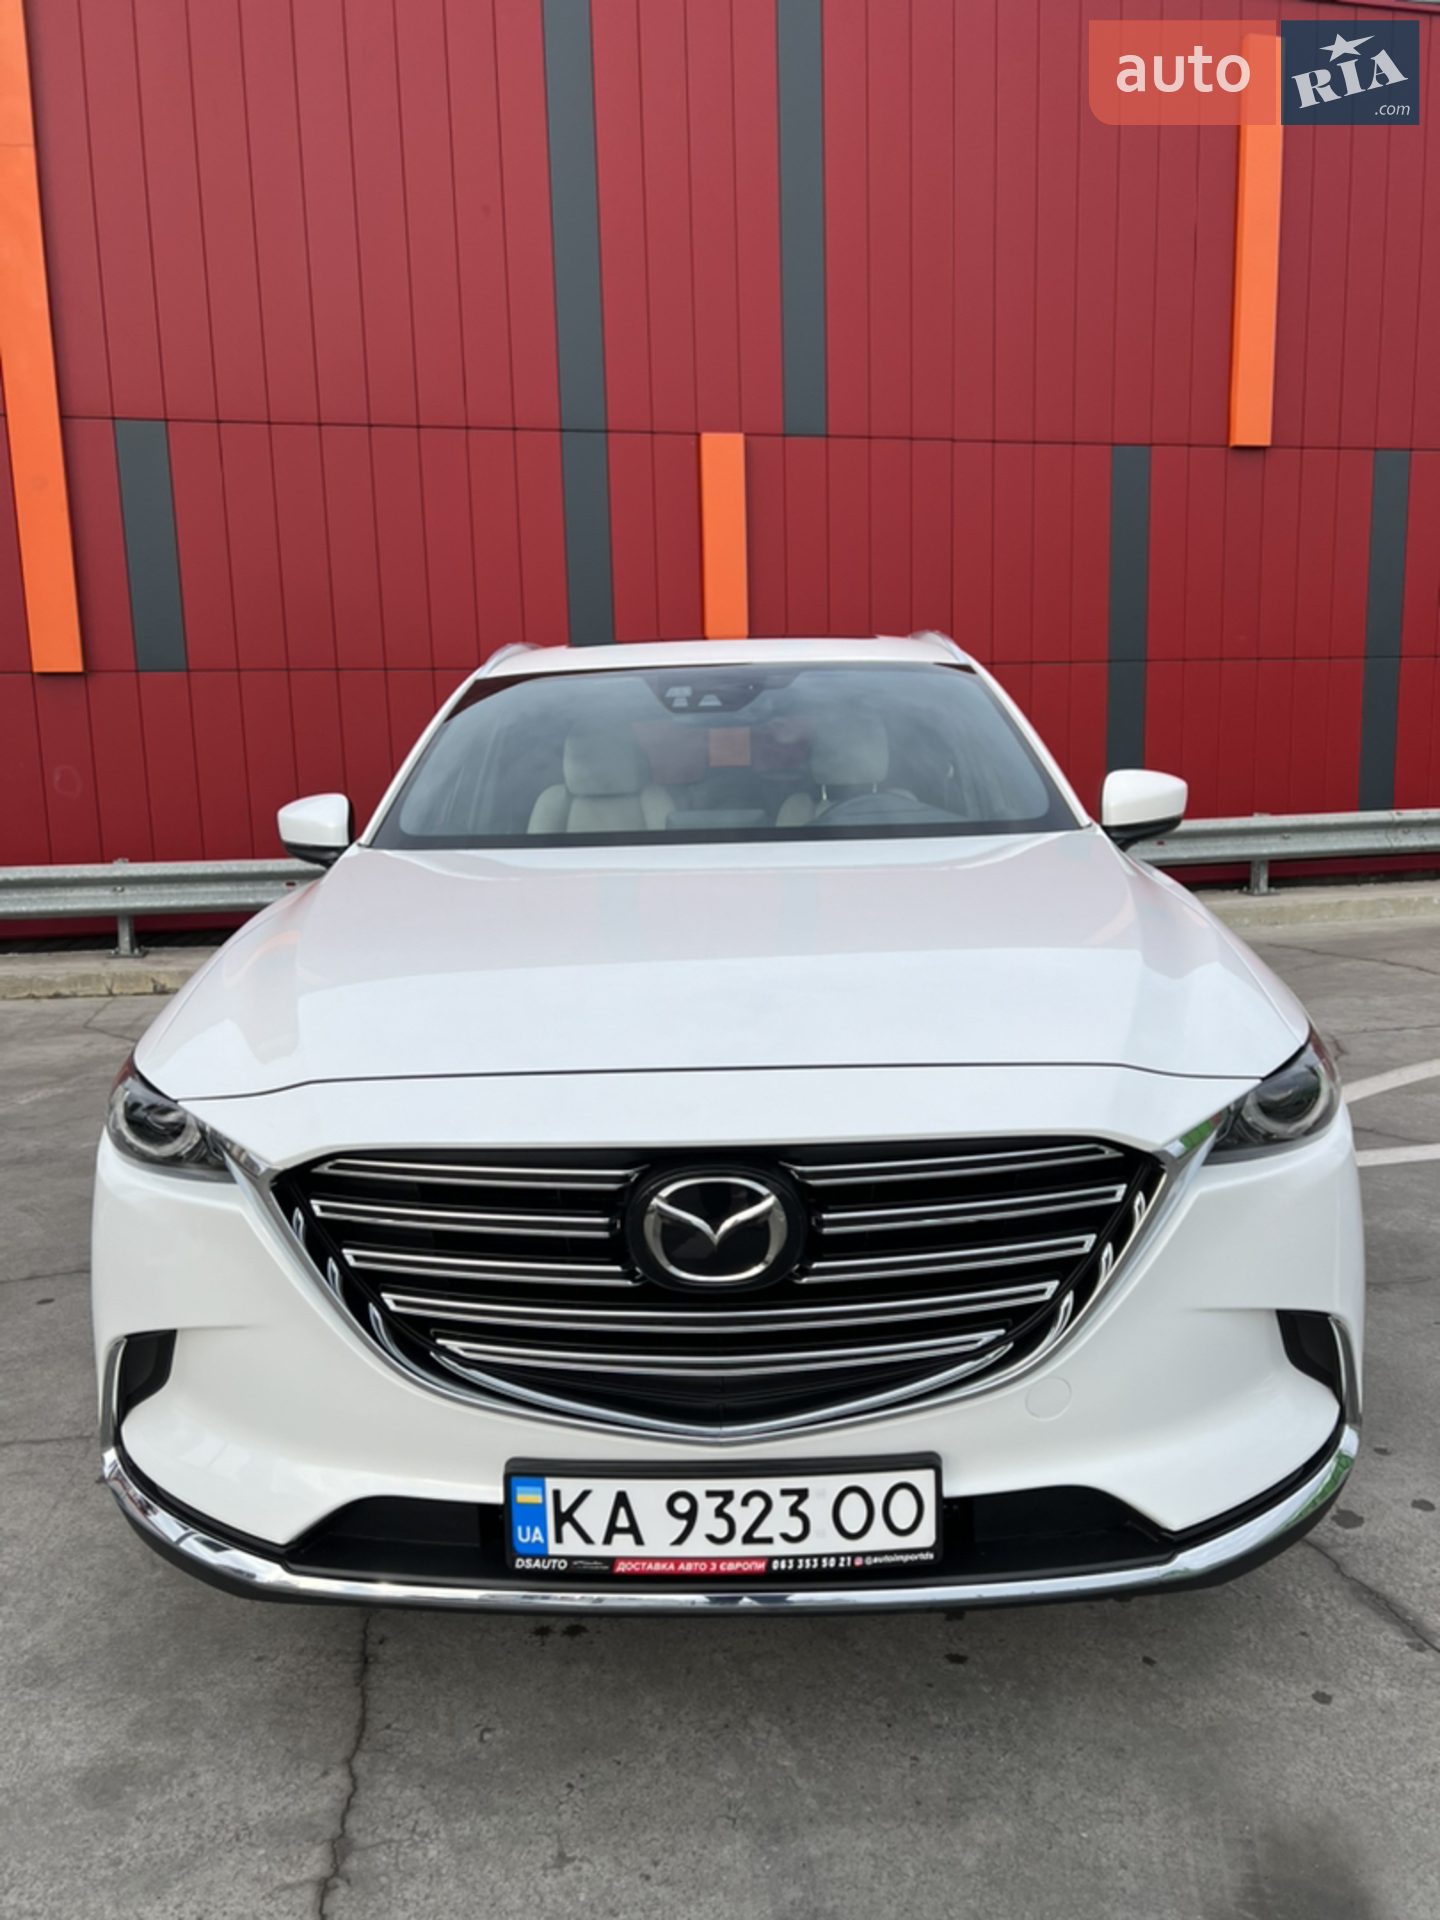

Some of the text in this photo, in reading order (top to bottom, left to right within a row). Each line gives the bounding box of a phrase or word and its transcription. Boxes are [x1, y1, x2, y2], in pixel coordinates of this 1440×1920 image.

[552, 1481, 925, 1546] KA 9323 OO
[516, 1525, 545, 1544] UA
[515, 1558, 568, 1571] DSAUTO
[615, 1561, 675, 1573] ДОСТАВКА
[677, 1561, 708, 1572] АВТО
[719, 1560, 766, 1572] ЄВРОПИ
[821, 1556, 836, 1569] 50
[838, 1555, 852, 1568] 21
